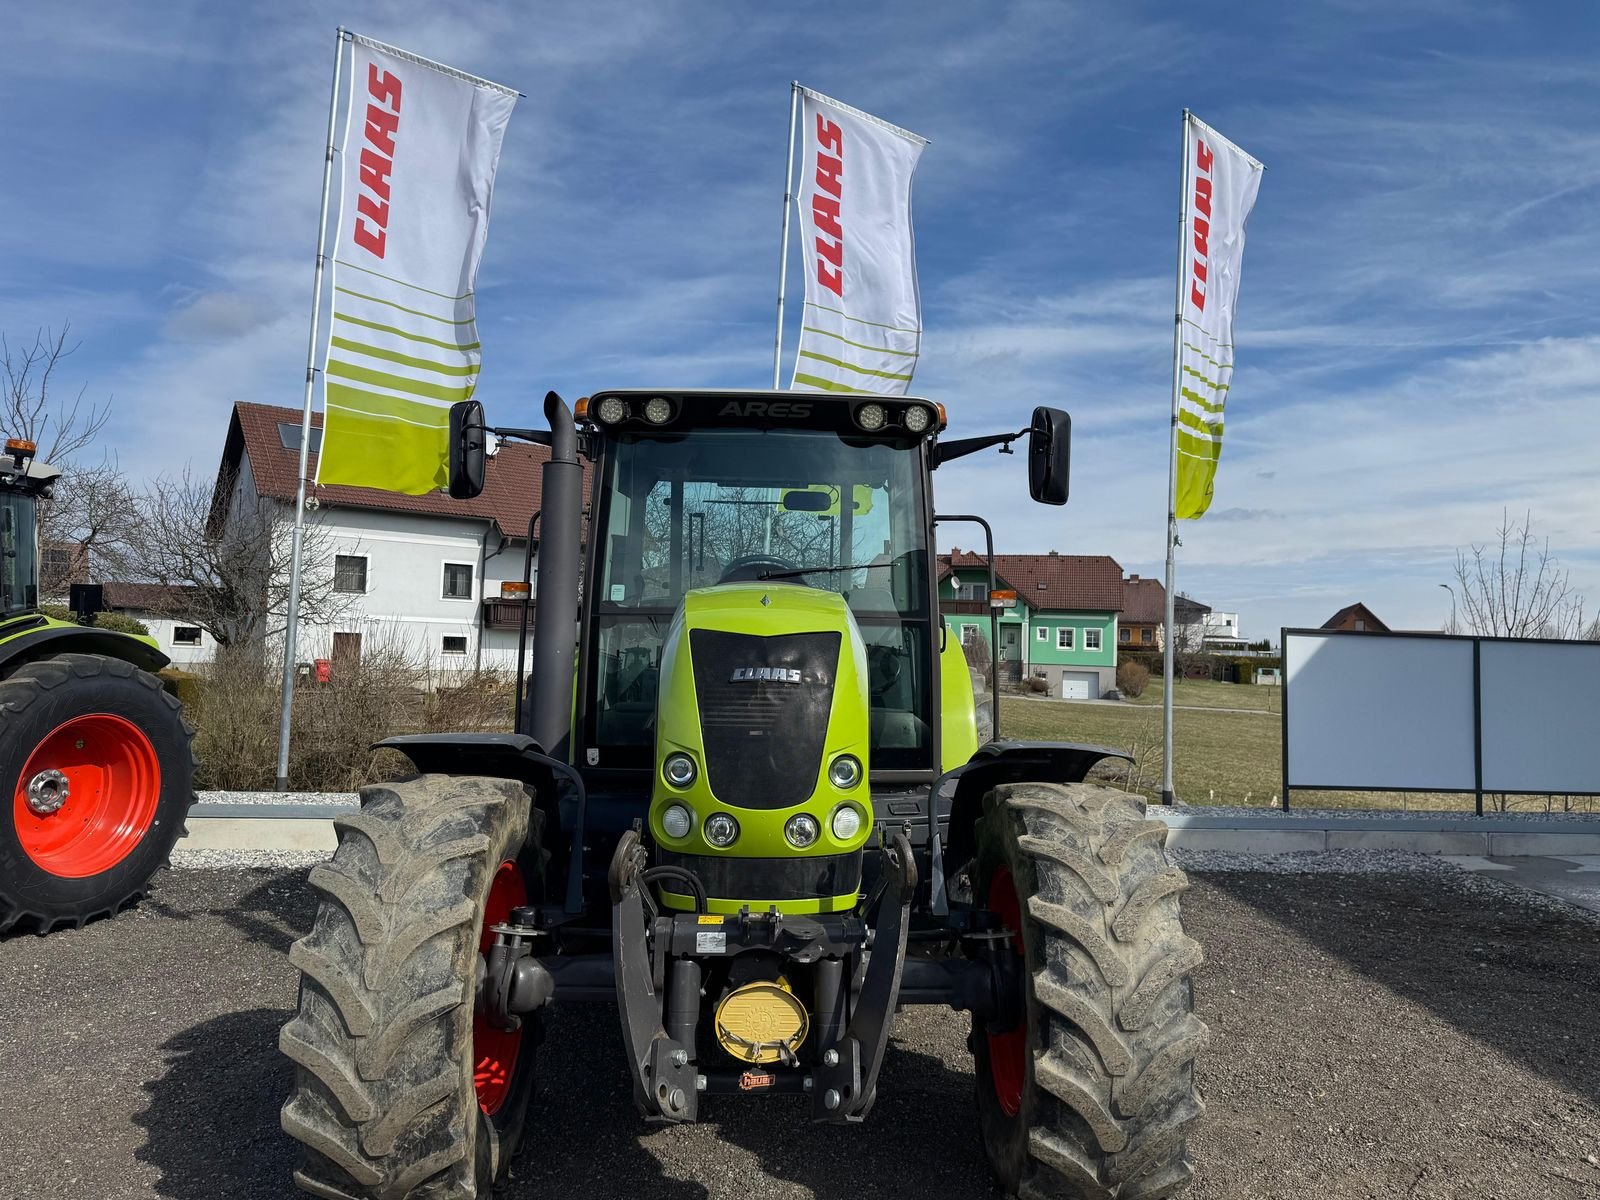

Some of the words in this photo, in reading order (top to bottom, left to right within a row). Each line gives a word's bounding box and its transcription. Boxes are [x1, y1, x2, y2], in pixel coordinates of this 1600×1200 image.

[353, 62, 403, 260] CLAAS
[812, 112, 843, 298] CLAAS
[1191, 138, 1214, 313] CLAAS
[717, 401, 814, 418] ARES
[731, 667, 801, 683] CLAAS
